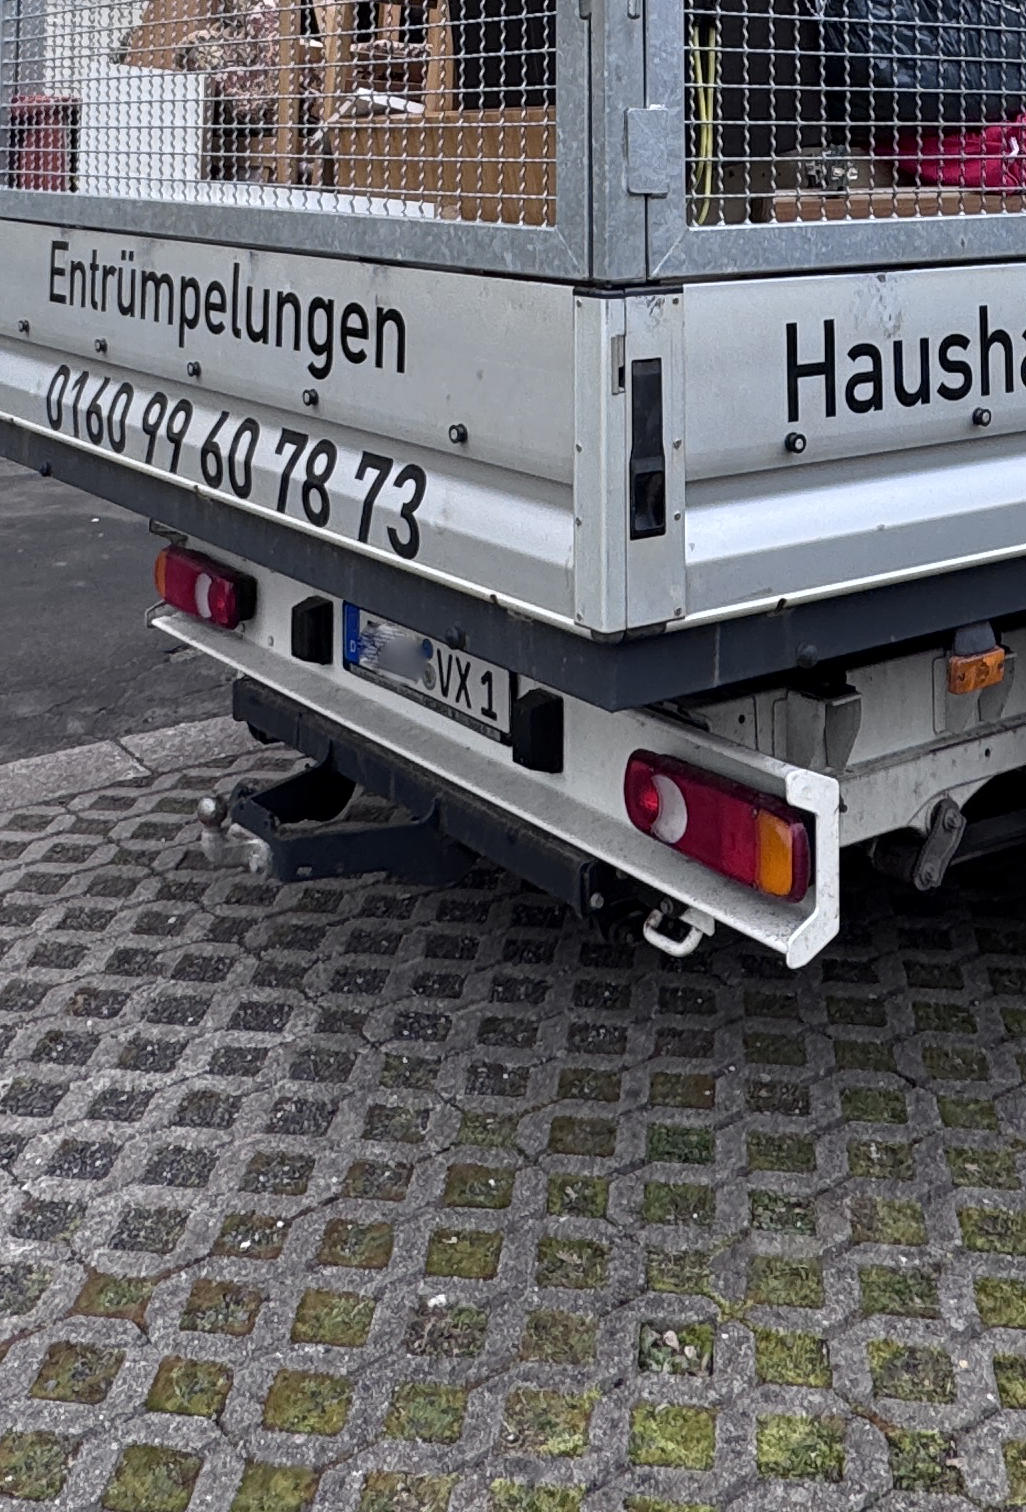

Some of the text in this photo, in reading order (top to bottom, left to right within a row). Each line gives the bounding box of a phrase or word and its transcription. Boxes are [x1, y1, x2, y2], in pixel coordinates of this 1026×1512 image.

[49, 240, 406, 379] Entrümpelungen
[46, 364, 427, 560] 0160 99 60 78 73
[436, 648, 472, 709] VX
[480, 670, 498, 721] 1
